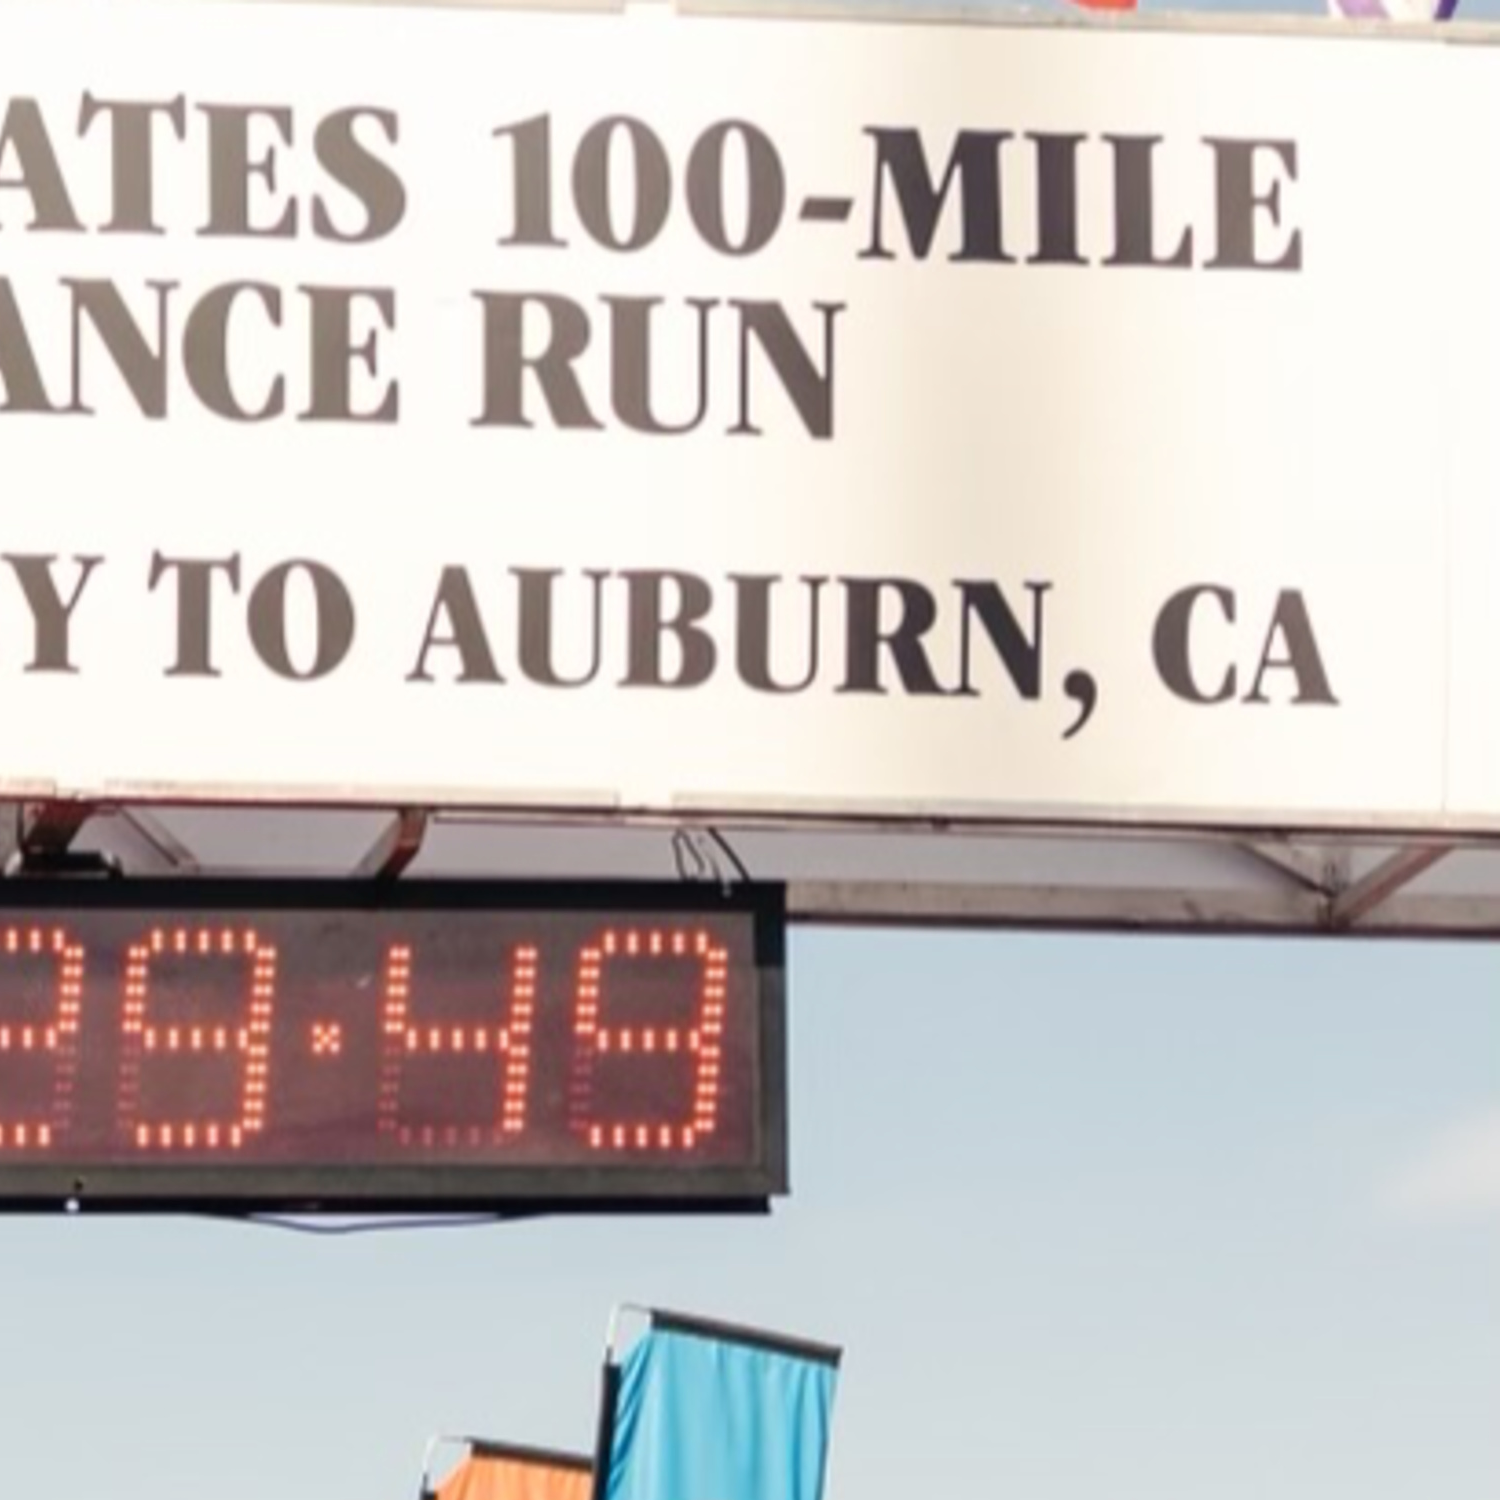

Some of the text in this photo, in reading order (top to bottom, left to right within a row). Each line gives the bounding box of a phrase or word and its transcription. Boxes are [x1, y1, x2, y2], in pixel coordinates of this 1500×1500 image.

[492, 112, 1303, 273] 100-MILE
[469, 289, 848, 442] RUN
[147, 549, 357, 682] TO
[404, 564, 1099, 742] AUBURN,
[1150, 582, 1340, 707] CA
